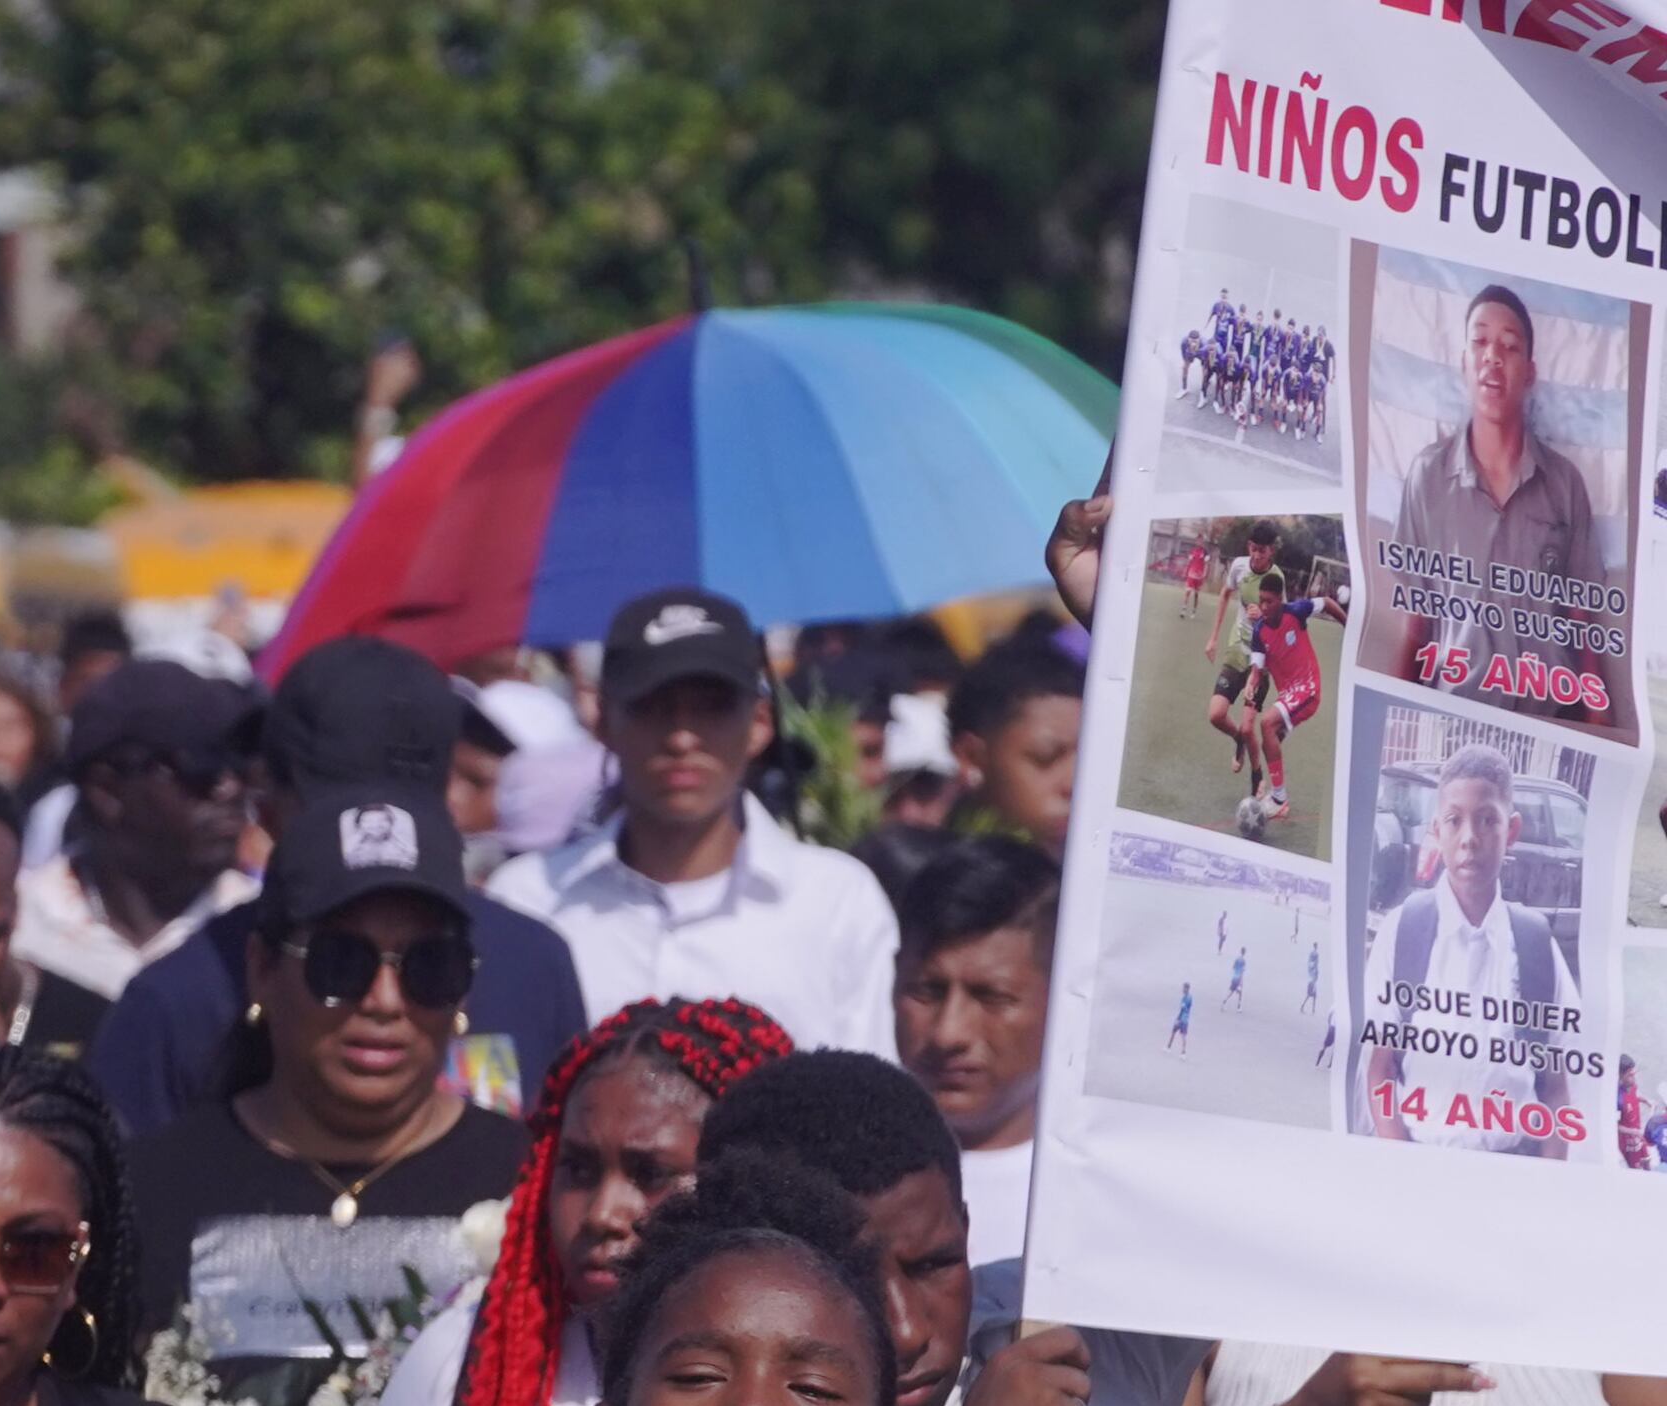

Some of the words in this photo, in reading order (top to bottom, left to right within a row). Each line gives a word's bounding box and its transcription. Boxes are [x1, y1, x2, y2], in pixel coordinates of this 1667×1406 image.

[1205, 70, 1424, 213] NIÑOS
[1377, 541, 1482, 587] ISMAEL
[1489, 562, 1627, 616] EDUARDO
[1392, 584, 1505, 631] ARROYO
[1512, 608, 1627, 656] BUSTOS
[1416, 641, 1470, 685] 15
[1478, 651, 1610, 709] AÑOS
[1377, 981, 1472, 1018] JOSUE
[1482, 995, 1582, 1033] DIDIER
[1359, 1019, 1479, 1060] ARROYO
[1489, 1037, 1605, 1078] BUSTOS
[1373, 1081, 1428, 1122] 14
[1444, 1088, 1588, 1142] AÑOS
